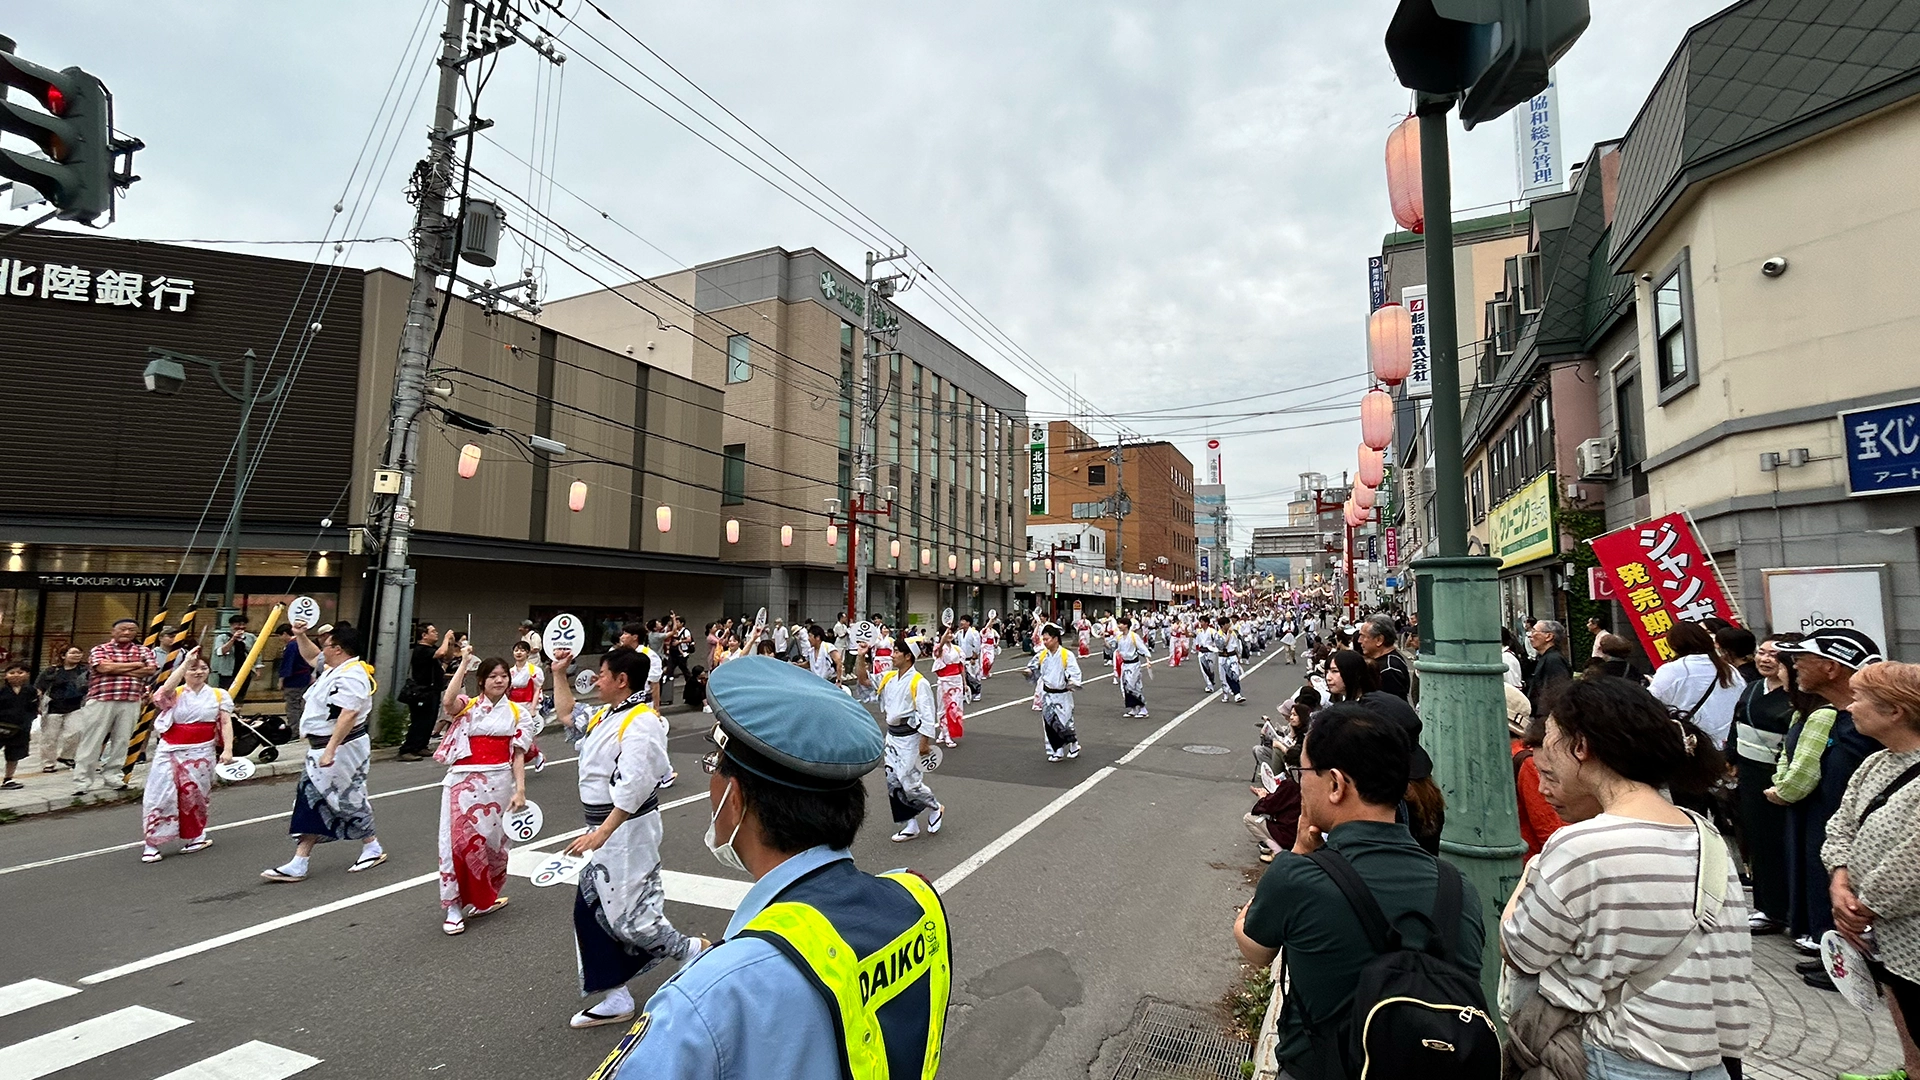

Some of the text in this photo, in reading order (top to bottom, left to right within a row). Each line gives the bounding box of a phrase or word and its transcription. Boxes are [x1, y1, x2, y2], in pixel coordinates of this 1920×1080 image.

[0, 258, 195, 312] 北陸銀行
[1411, 313, 1429, 382] 杉商株式会社
[1855, 414, 1919, 460] 宝くじ
[1032, 450, 1043, 505] 北海道銀行
[38, 576, 166, 586] THE HOKURIKU BANK
[1800, 612, 1854, 631] ploom
[859, 933, 925, 1008] DAIKO
